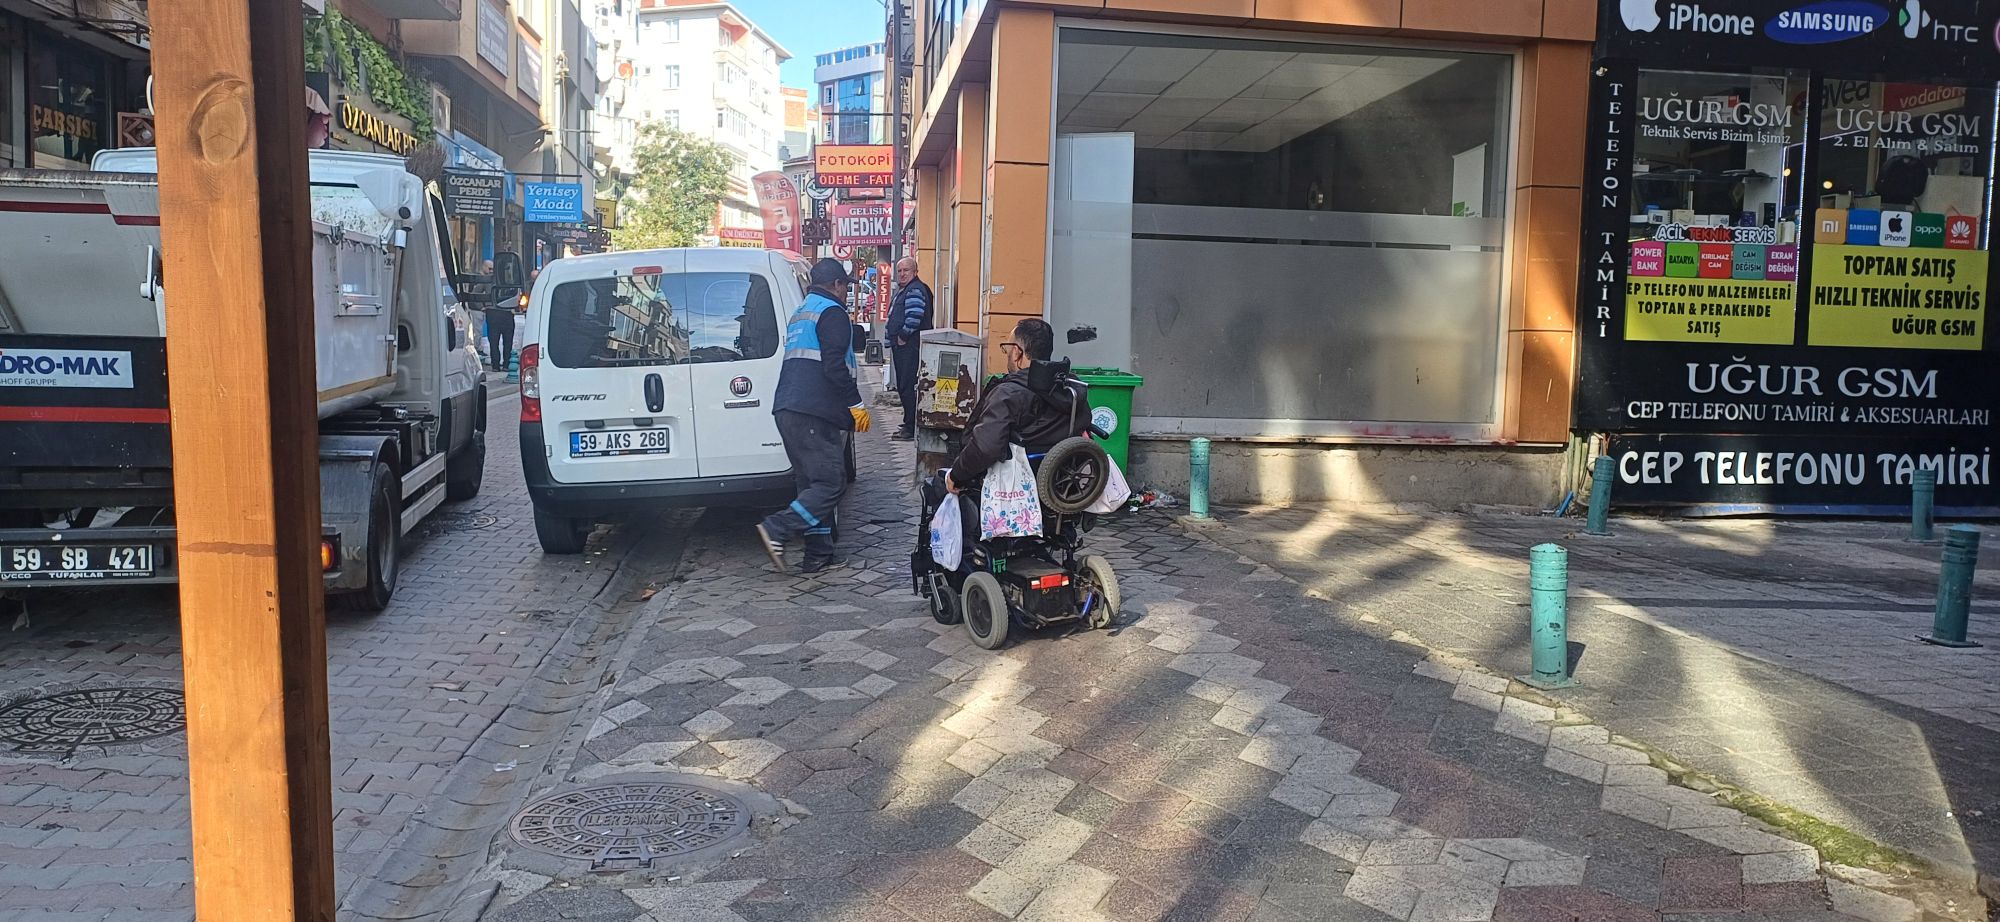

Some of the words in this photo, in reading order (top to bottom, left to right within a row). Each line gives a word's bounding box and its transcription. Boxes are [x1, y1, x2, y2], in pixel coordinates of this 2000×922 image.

[1669, 3, 1755, 35] iPhone
[1778, 10, 1875, 34] SAMSUNG
[1642, 91, 1724, 124] UĞUR
[1732, 102, 1793, 127] GSM
[1836, 103, 1914, 134] UĞUR
[1922, 112, 1980, 137] GSM
[1641, 124, 1680, 139] Teknik
[1683, 127, 1718, 141] Servis
[1721, 129, 1754, 143] Bizim
[1833, 134, 1847, 147] 2.
[1853, 135, 1868, 148] El
[1874, 137, 1911, 150] Alım
[1917, 140, 1929, 151] &
[1602, 83, 1623, 208] TELEFON
[820, 153, 890, 166] FOTOKOPİ
[449, 175, 501, 188] ÖZCANLAR
[820, 173, 860, 185] ÖDEME
[864, 174, 893, 185] -FAT
[459, 187, 491, 197] PERDE
[528, 184, 579, 200] Yenisey
[532, 198, 574, 210] Moda
[1657, 224, 1685, 240] ACİL
[1690, 225, 1732, 242] TEKNİK
[1734, 227, 1776, 244] SERVİS
[1849, 224, 1877, 232] SAMSUNG
[1884, 233, 1907, 242] iPhone
[1634, 247, 1662, 258] POWER
[1669, 254, 1695, 265] BATARYA
[1701, 253, 1730, 261] KIRILMAZ
[1742, 250, 1756, 259] CAM
[1771, 251, 1793, 260] EKRAN
[1637, 261, 1659, 271] BANK
[1708, 261, 1722, 269] CAM
[1844, 255, 1907, 276] TOPTAN
[1911, 257, 1957, 284] SATIŞ
[880, 265, 889, 321] VESTEL
[1596, 232, 1615, 338] TAMİRİ
[1644, 283, 1704, 298] TELEFONU
[1708, 284, 1792, 301] MALZEMELERİ
[1815, 286, 1857, 307] HIZLI
[1861, 282, 1922, 309] TEKNİK
[1924, 284, 1980, 310] SERVİS
[1638, 301, 1685, 315] TOPTAN
[1689, 303, 1697, 316] &
[1700, 303, 1771, 318] PERAKENDE
[1687, 320, 1721, 338] SATIŞ
[1892, 314, 1937, 335] UĞUR
[1941, 319, 1976, 336] GSM
[25, 377, 57, 386] GRUPPE
[1686, 355, 1823, 396] UĞUR
[1837, 367, 1938, 399] GSM
[1627, 401, 1664, 419] CEP
[1668, 401, 1766, 421] TELEFONU
[1772, 401, 1835, 423] TAMİRİ
[1840, 407, 1851, 423] &
[1855, 407, 1990, 426] AKSESUARLARI
[580, 434, 597, 450] 59
[606, 433, 631, 449] AKS
[640, 432, 665, 448] 268
[1619, 450, 1684, 485] CEP
[1694, 451, 1865, 485] TELEFONU
[1876, 446, 1991, 486] TAMİRİ
[13, 548, 41, 571] 59
[61, 548, 89, 570] SB
[108, 547, 147, 569] 421
